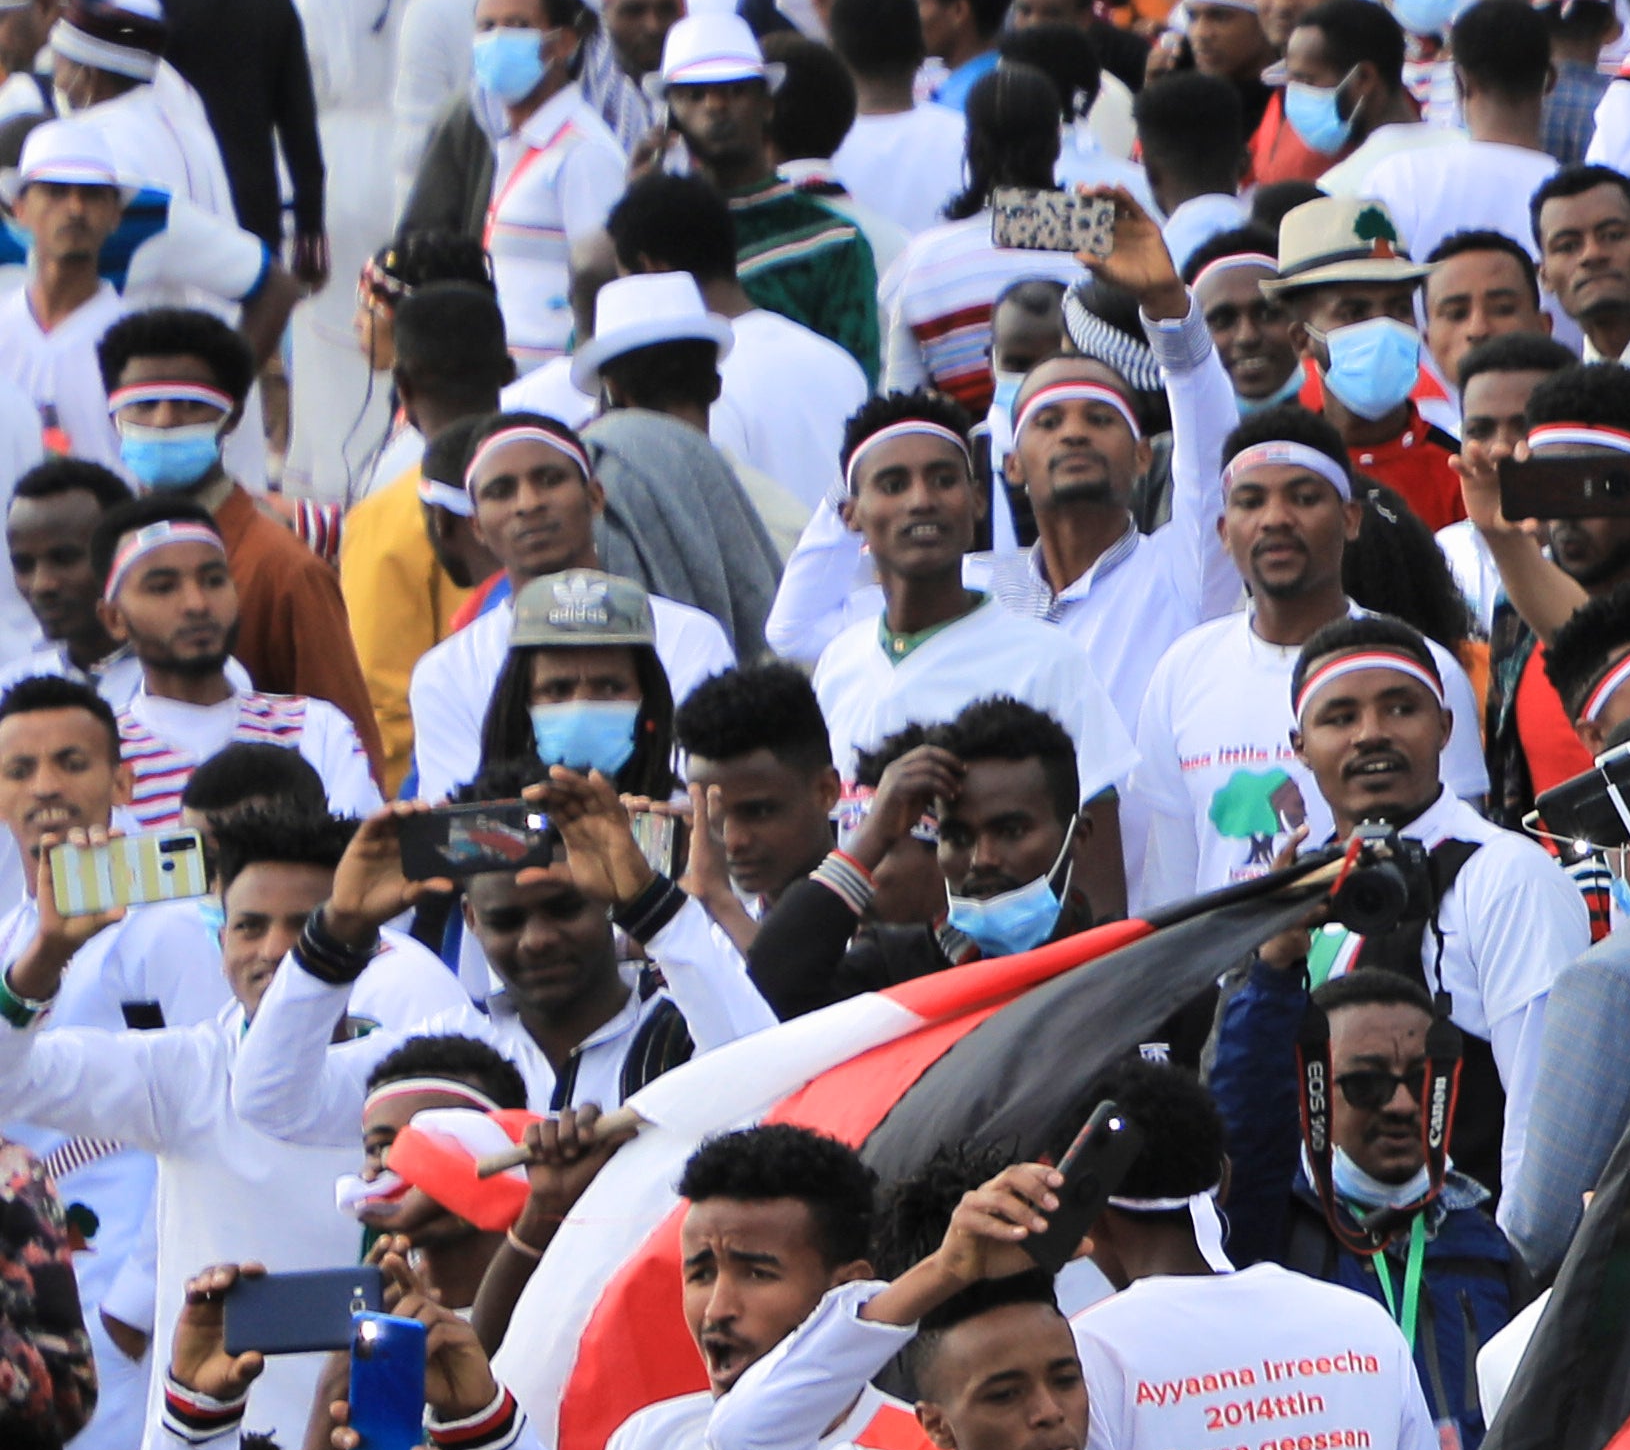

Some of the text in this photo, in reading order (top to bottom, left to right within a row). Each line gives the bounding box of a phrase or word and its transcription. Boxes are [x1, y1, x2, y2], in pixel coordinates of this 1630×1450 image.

[548, 604, 608, 624] adidas
[1307, 1060, 1327, 1113] EOS
[1429, 1076, 1448, 1148] Canon
[1135, 1349, 1380, 1407] Ayyaana Irreecha
